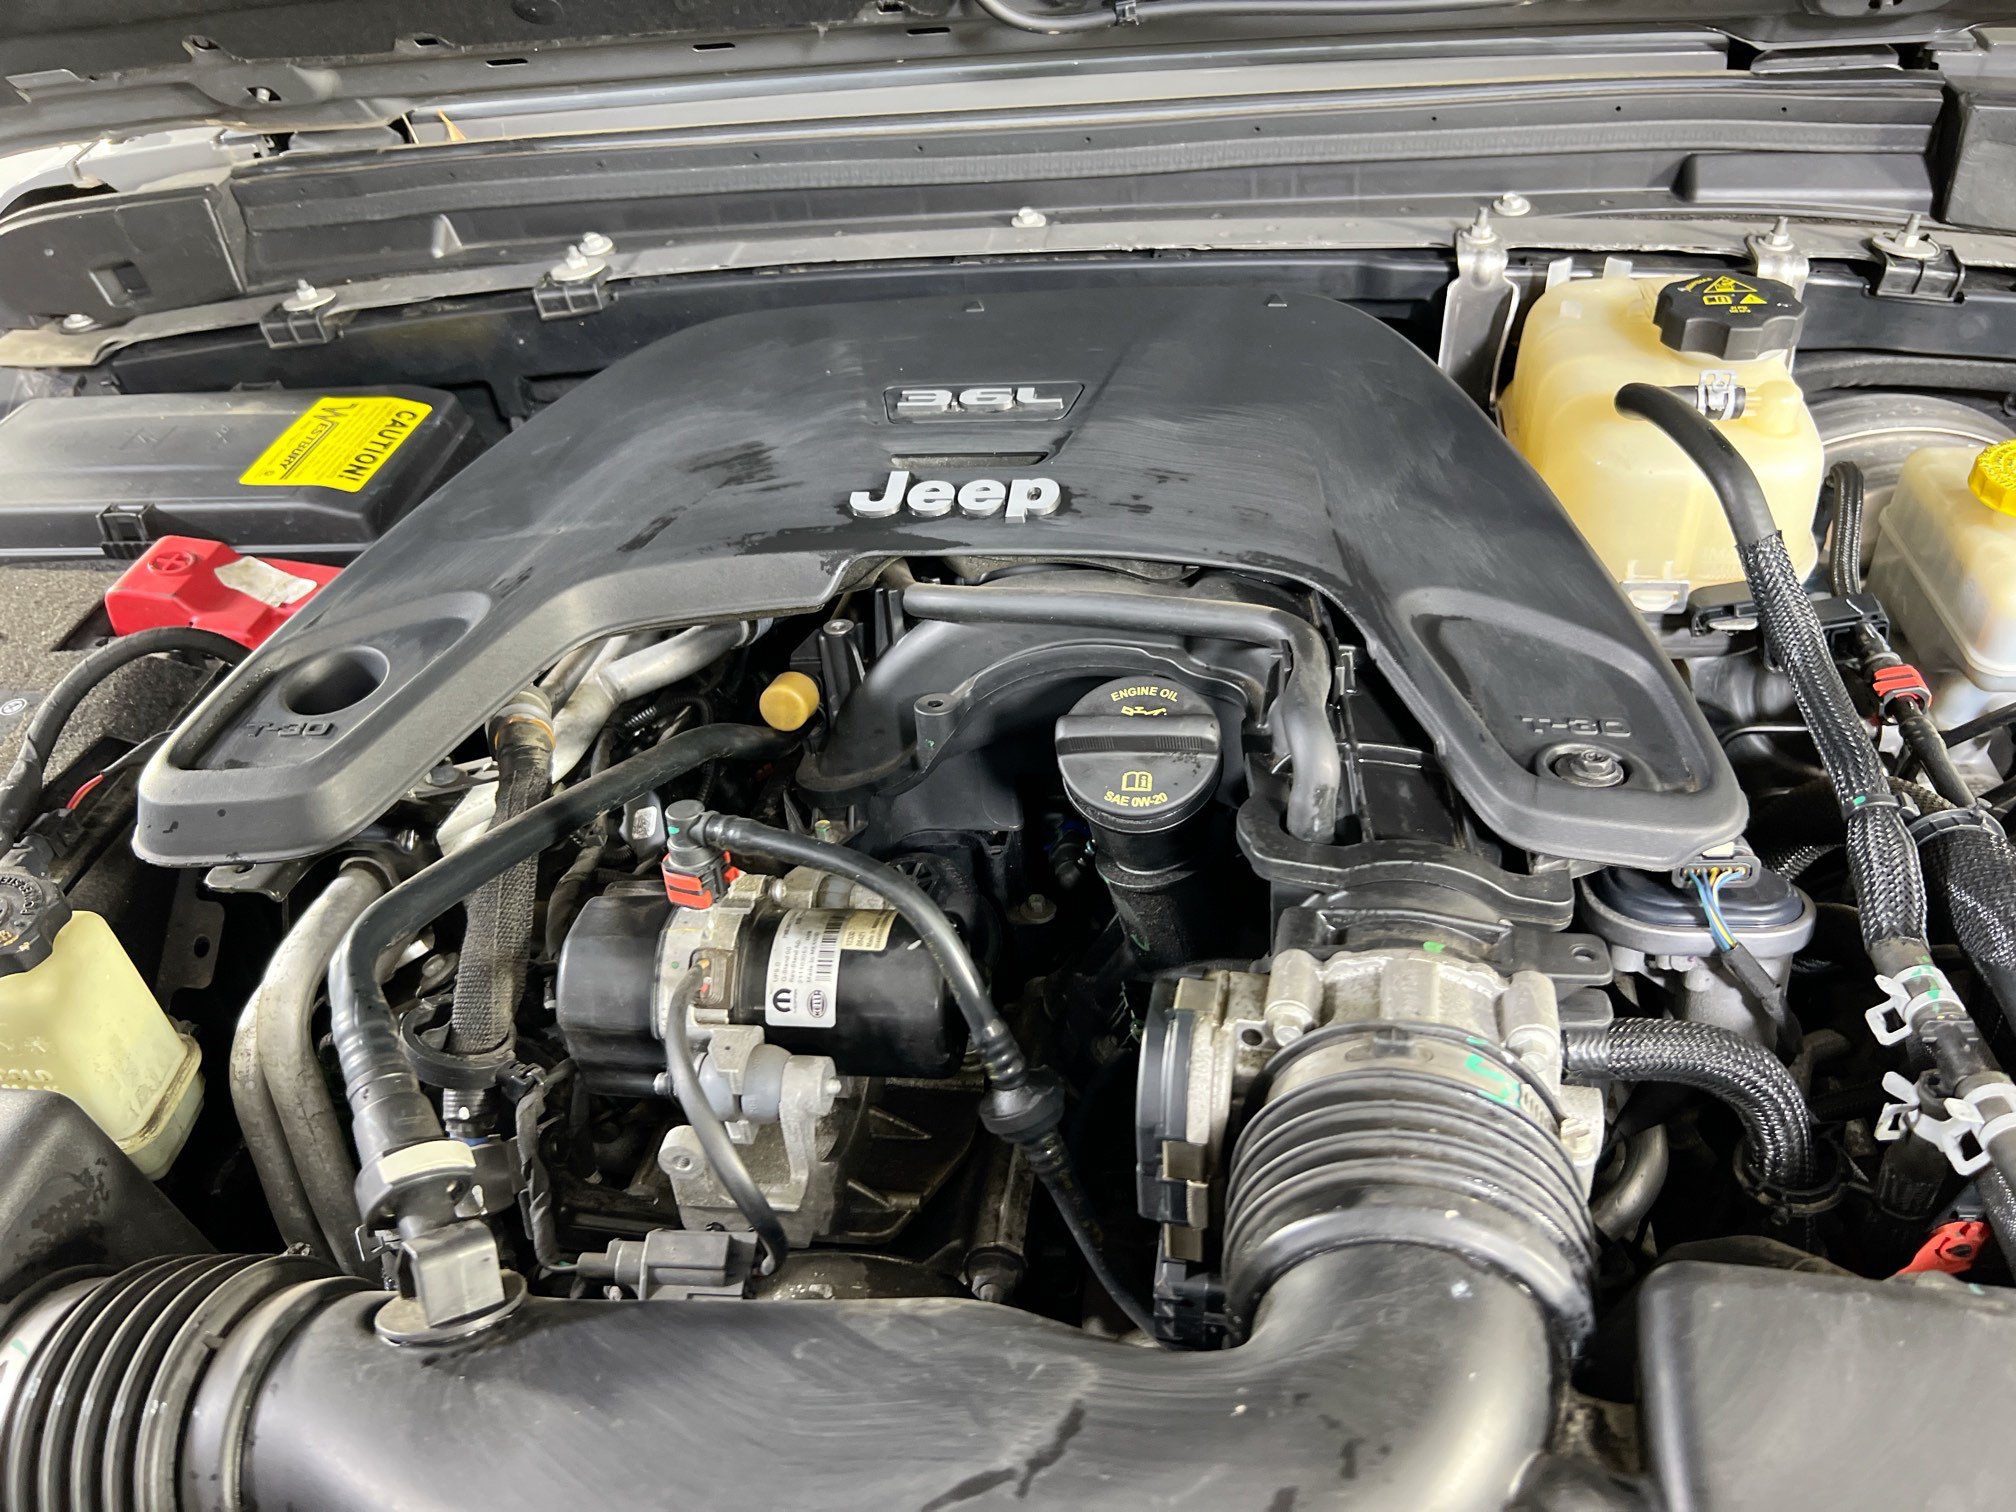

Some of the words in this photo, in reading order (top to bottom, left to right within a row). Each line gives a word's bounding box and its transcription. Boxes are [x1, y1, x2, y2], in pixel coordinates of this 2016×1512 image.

[337, 410, 418, 482] CAUTION!
[849, 470, 1062, 524] Jeep
[1110, 686, 1159, 702] ENGINE
[1160, 688, 1179, 702] OIL
[246, 720, 334, 738] T-30
[1520, 717, 1632, 738] T-30
[1103, 789, 1129, 807] SAE
[1131, 791, 1168, 808] 0W-20
